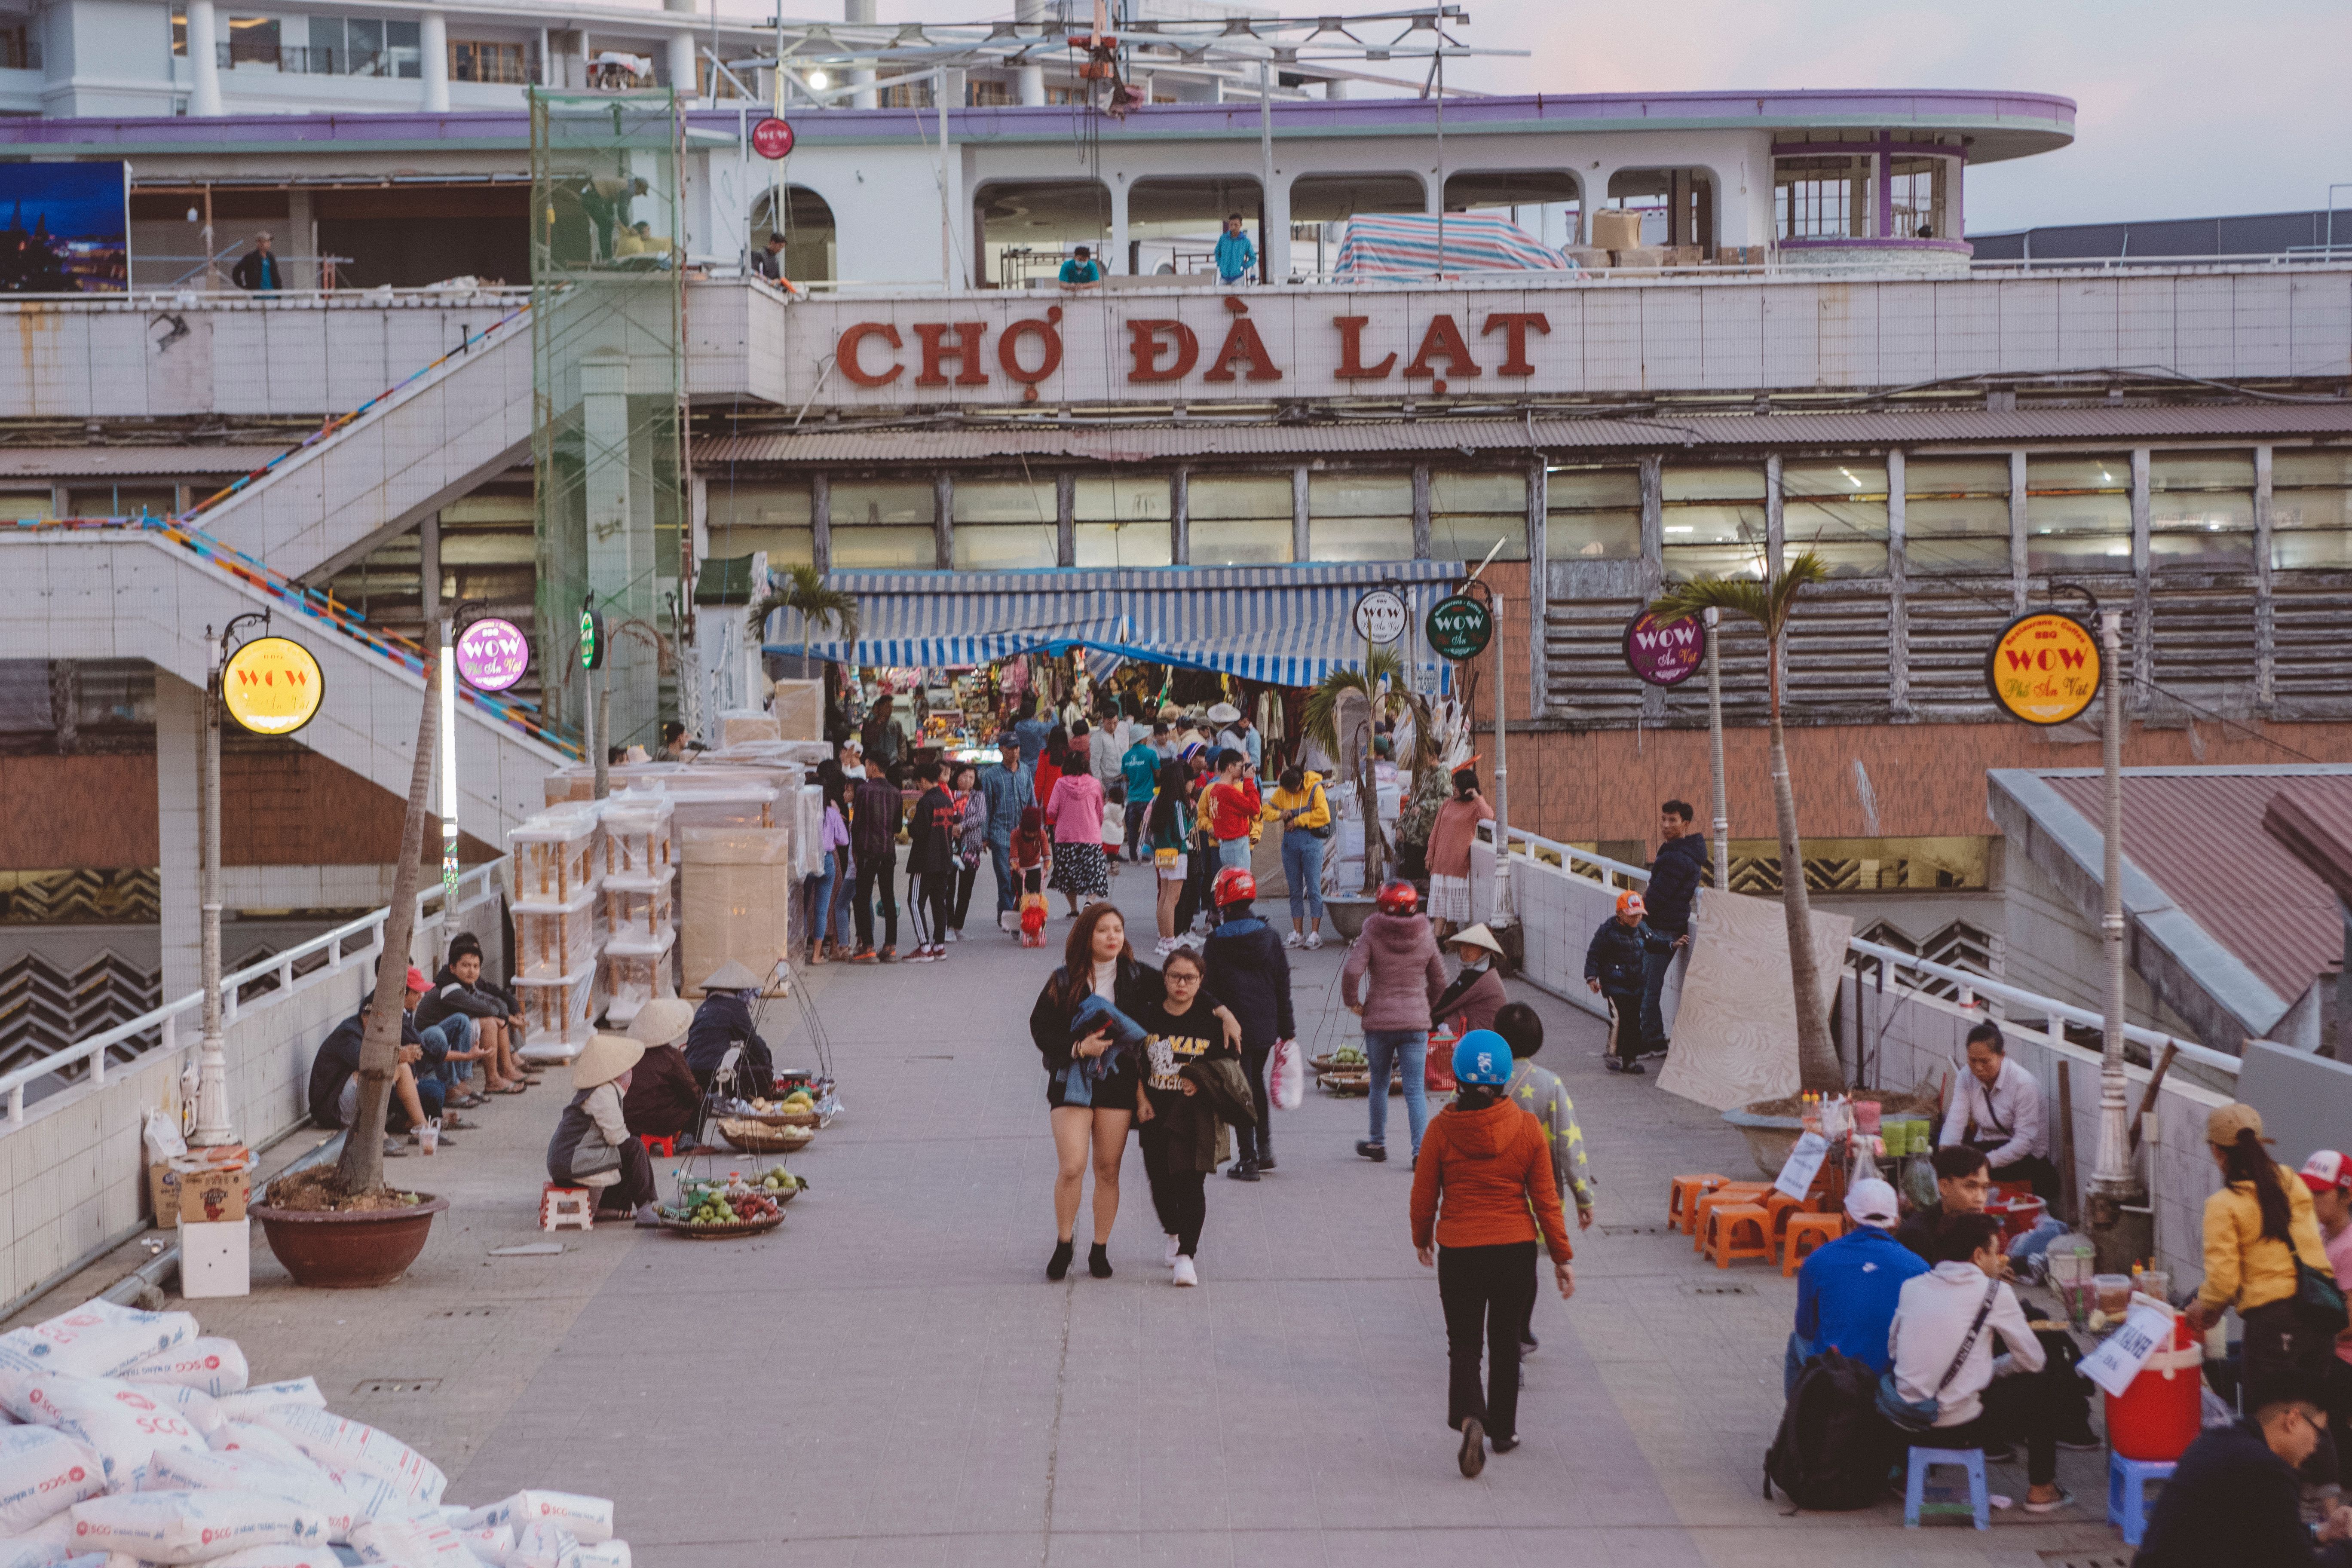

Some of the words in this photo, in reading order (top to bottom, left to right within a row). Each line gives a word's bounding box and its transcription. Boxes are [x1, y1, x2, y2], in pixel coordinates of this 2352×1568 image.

[836, 305, 1063, 402] CHỢ
[1126, 296, 1283, 382] ĐÀ
[1333, 312, 1551, 393] LẠT
[1363, 606, 1401, 619] WOW
[1435, 615, 1483, 632] WOW
[1636, 625, 1696, 650] WOW
[2035, 631, 2058, 639] BBQ
[462, 637, 521, 659] WOW
[2005, 647, 2088, 672] WOW
[237, 669, 311, 687] WOW
[214, 1526, 231, 1541] SCG
